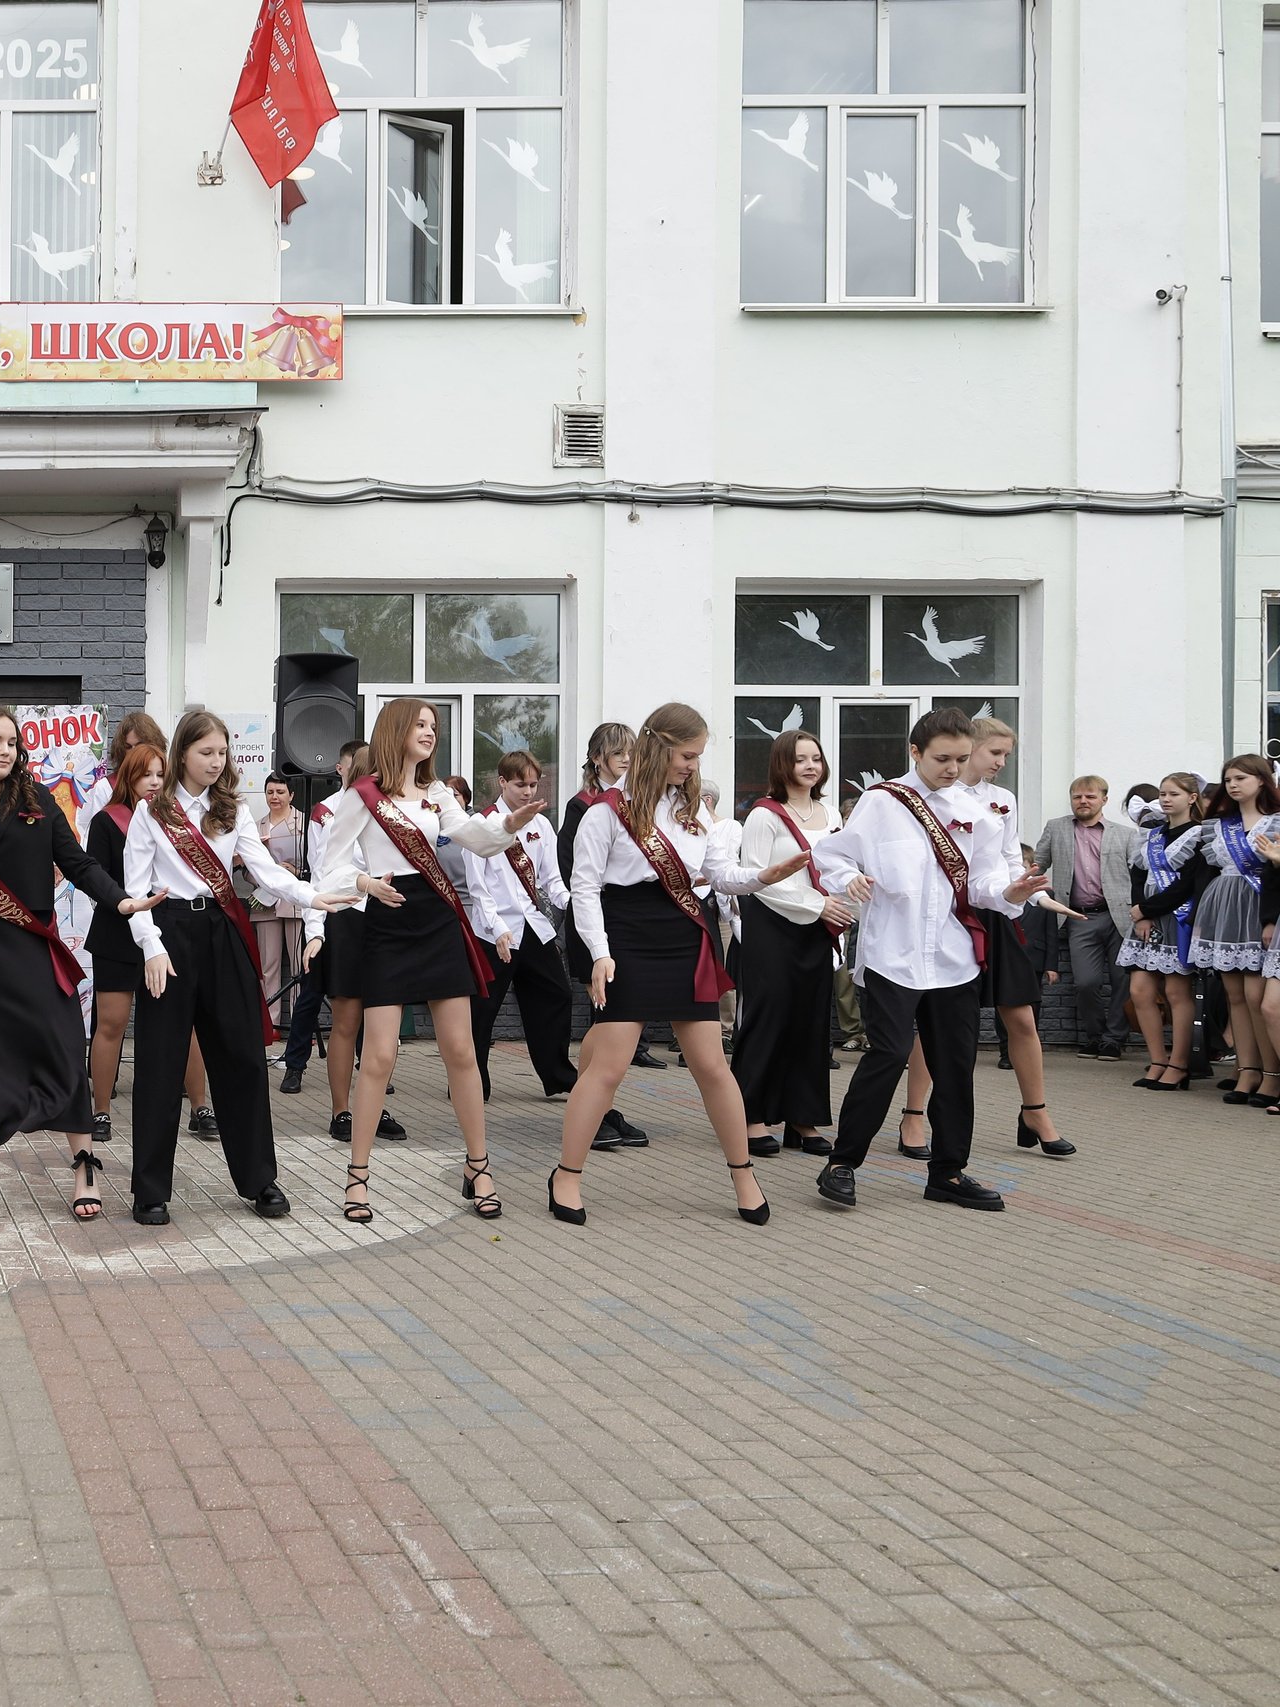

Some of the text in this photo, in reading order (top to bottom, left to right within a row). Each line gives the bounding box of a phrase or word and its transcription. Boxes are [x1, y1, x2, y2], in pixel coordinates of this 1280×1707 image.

[273, 23, 291, 57] УЗОВА
[29, 322, 247, 362] ШКОЛА!
[21, 713, 101, 751] ОНОК
[672, 885, 702, 915] 2025
